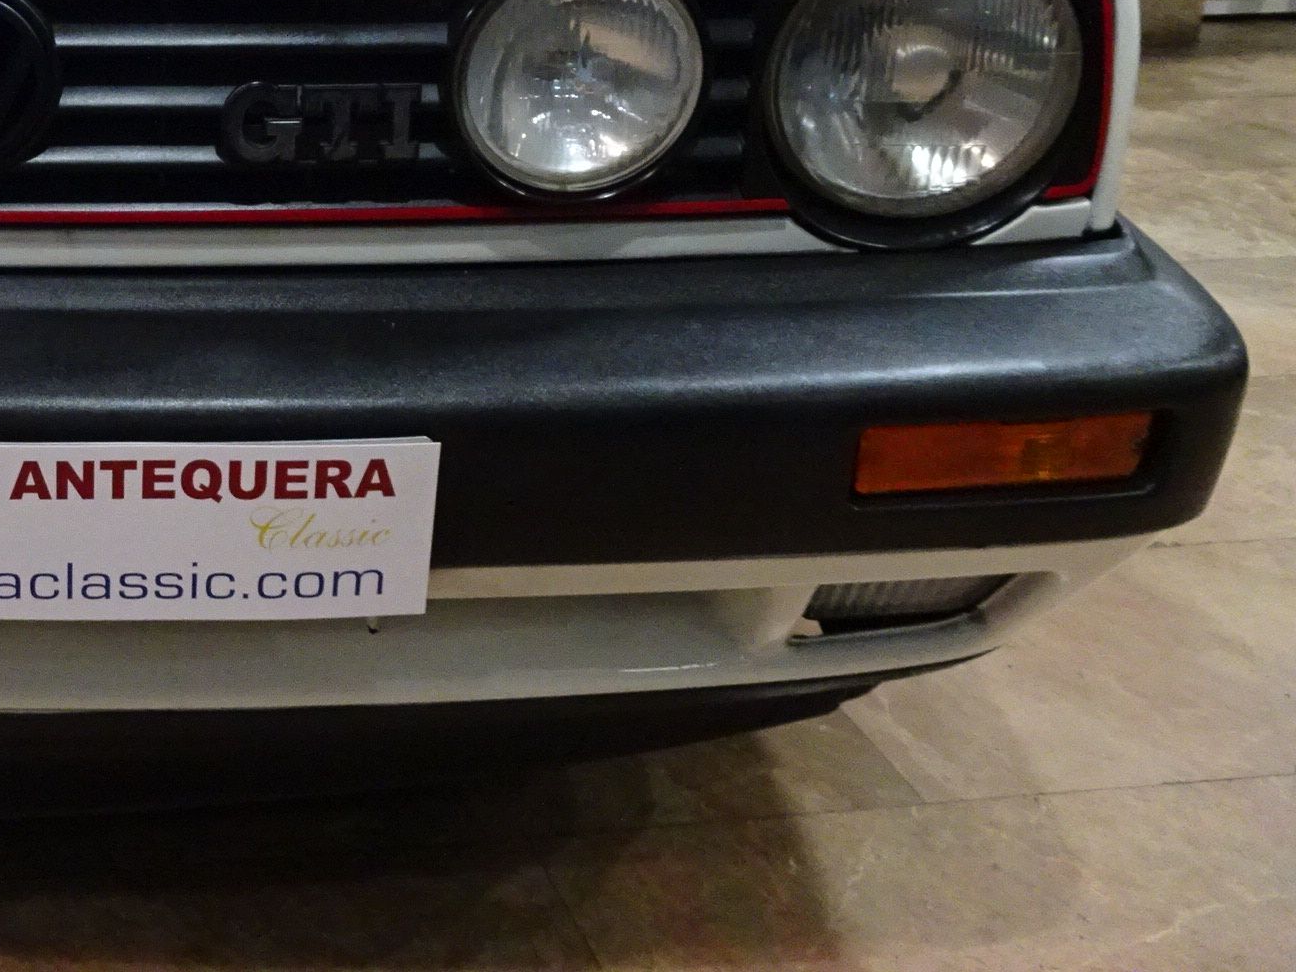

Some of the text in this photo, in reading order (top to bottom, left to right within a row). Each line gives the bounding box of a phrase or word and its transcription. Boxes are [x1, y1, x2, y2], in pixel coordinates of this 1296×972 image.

[222, 81, 422, 161] GTI
[9, 459, 396, 503] ANTEQUERA
[249, 506, 392, 552] Classic
